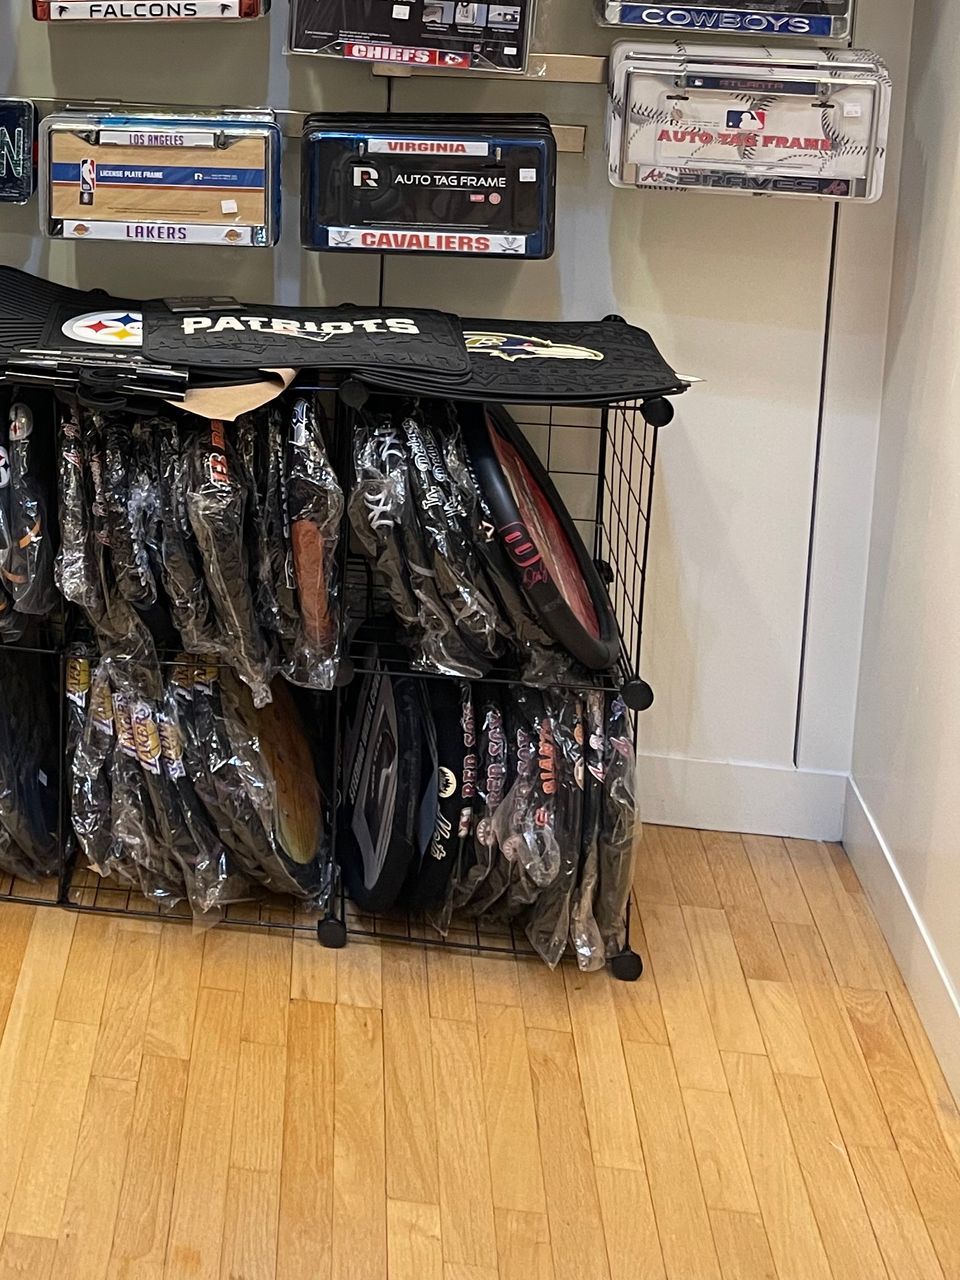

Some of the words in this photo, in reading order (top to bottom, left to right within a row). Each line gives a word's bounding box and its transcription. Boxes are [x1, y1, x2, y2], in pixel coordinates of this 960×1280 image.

[89, 3, 197, 18] FALCONS
[641, 9, 811, 33] COWBOYS
[351, 44, 430, 63] CHIEFS
[719, 79, 785, 89] ATLANTA
[129, 133, 145, 145] LOS
[148, 134, 184, 146] ANGELES
[387, 141, 467, 153] VIRGINIA
[657, 130, 714, 144] AUTO
[717, 133, 758, 147] TAG
[762, 136, 833, 151] FRAME
[100, 169, 123, 178] LICENSE
[124, 170, 142, 178] PLATE
[143, 170, 163, 179] FRAME
[394, 173, 431, 186] AUTO
[433, 175, 458, 186] TAG
[460, 176, 507, 188] FRAME
[677, 172, 819, 193] BRAVES
[126, 225, 187, 240] LAKERS
[361, 233, 490, 252] CAVALIERS
[181, 316, 421, 335] PATRIOTS
[461, 754, 476, 799] RED
